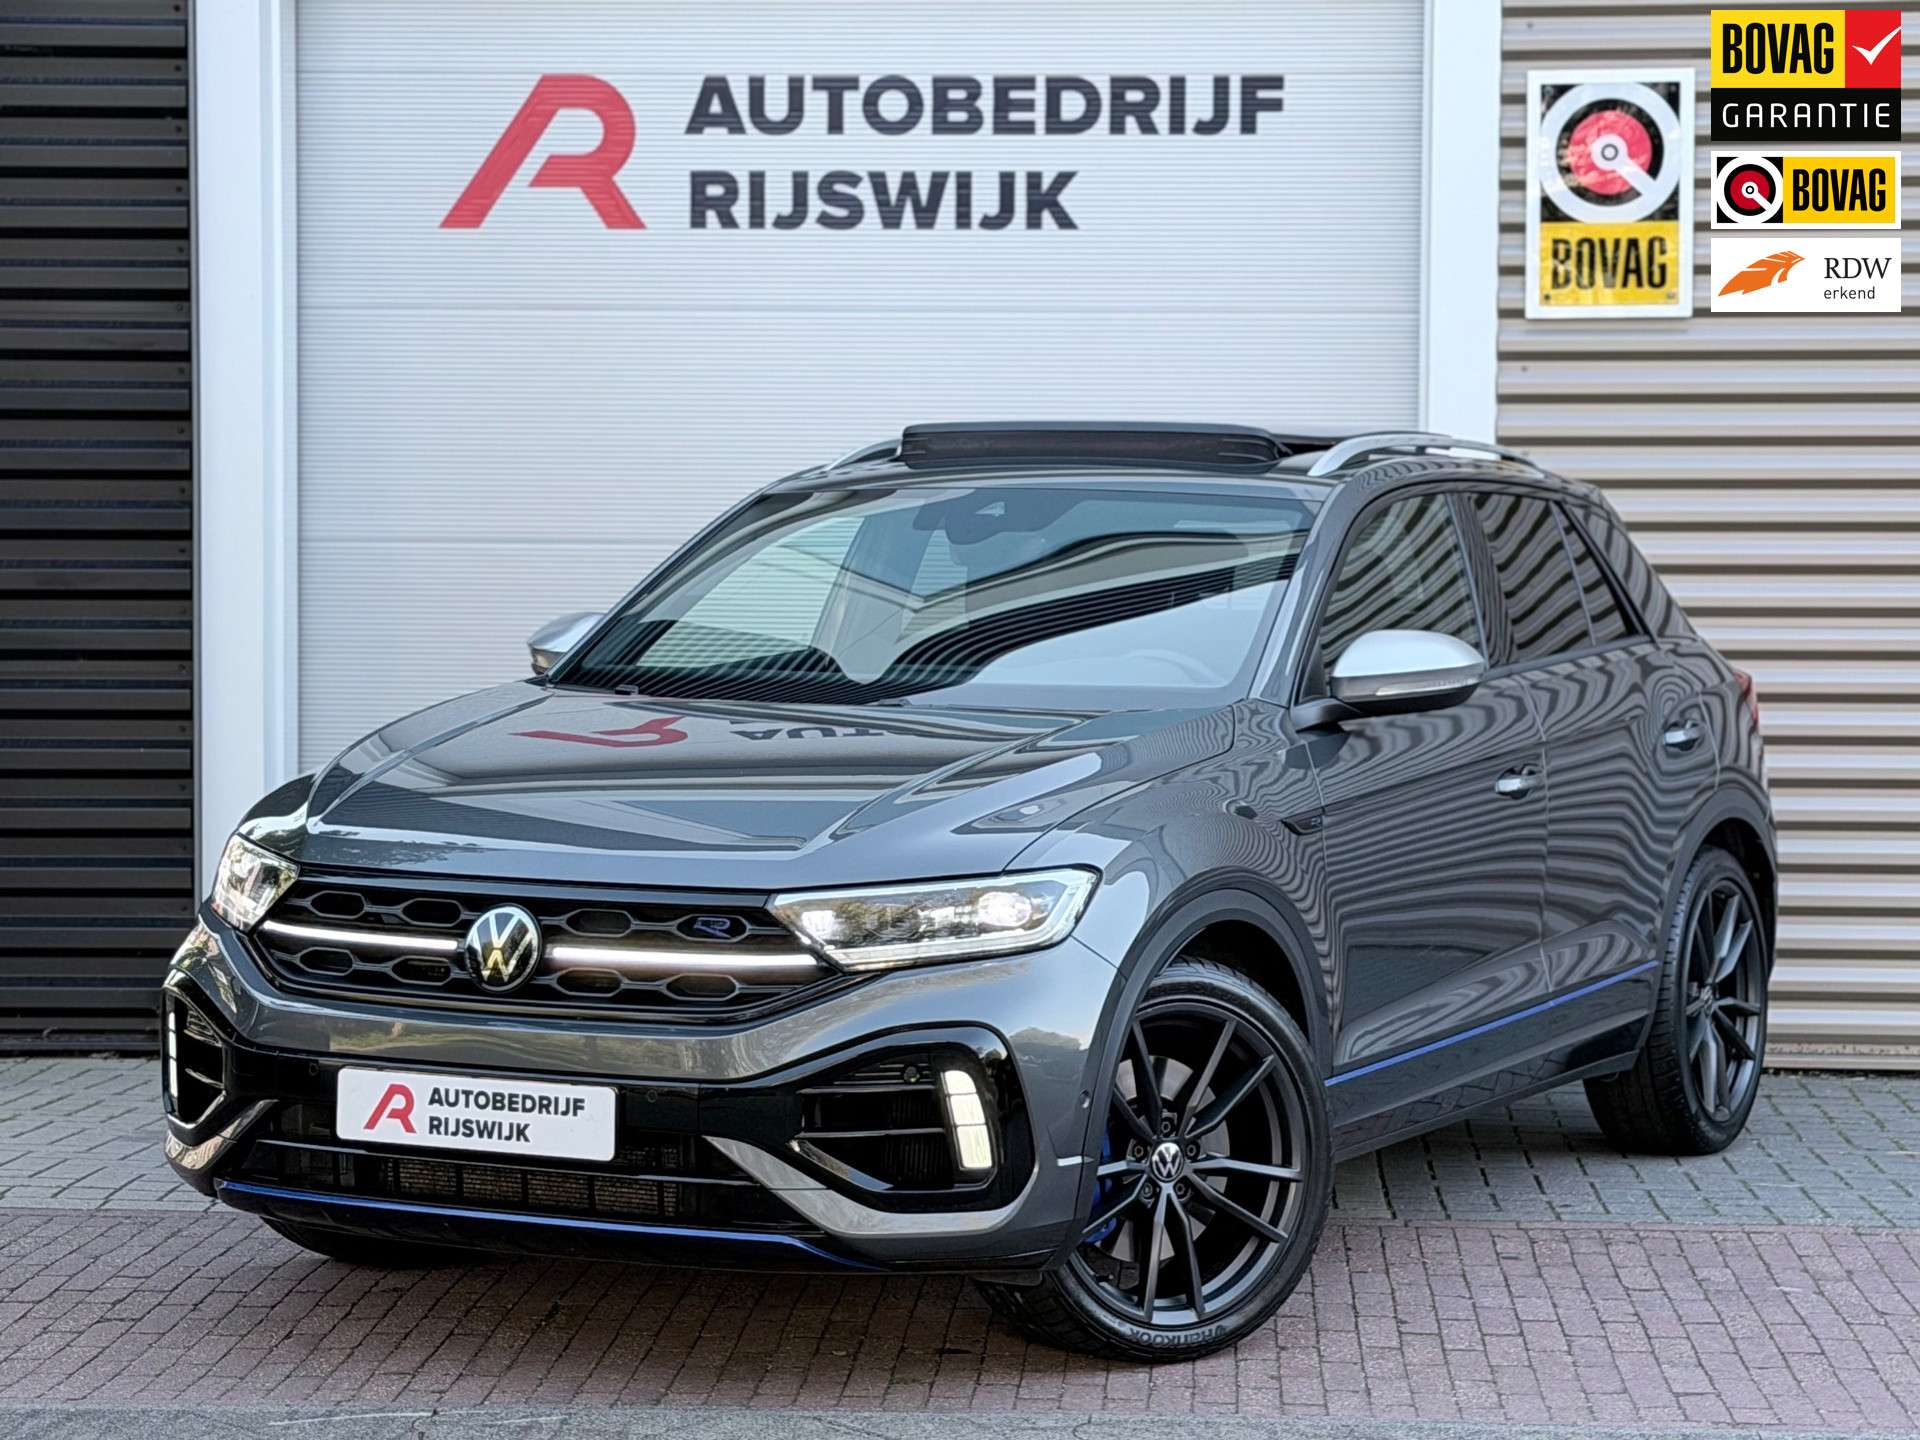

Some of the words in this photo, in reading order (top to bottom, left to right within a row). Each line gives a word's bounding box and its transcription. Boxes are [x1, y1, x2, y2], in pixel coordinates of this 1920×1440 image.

[684, 74, 1285, 136] AUTOBEDRIJF
[689, 170, 1078, 230] RIJSWIJK
[1551, 236, 1667, 290] BOVAG
[427, 1087, 586, 1117] AUTOBEDRIJF
[428, 1116, 531, 1143] RIJSWIJK
